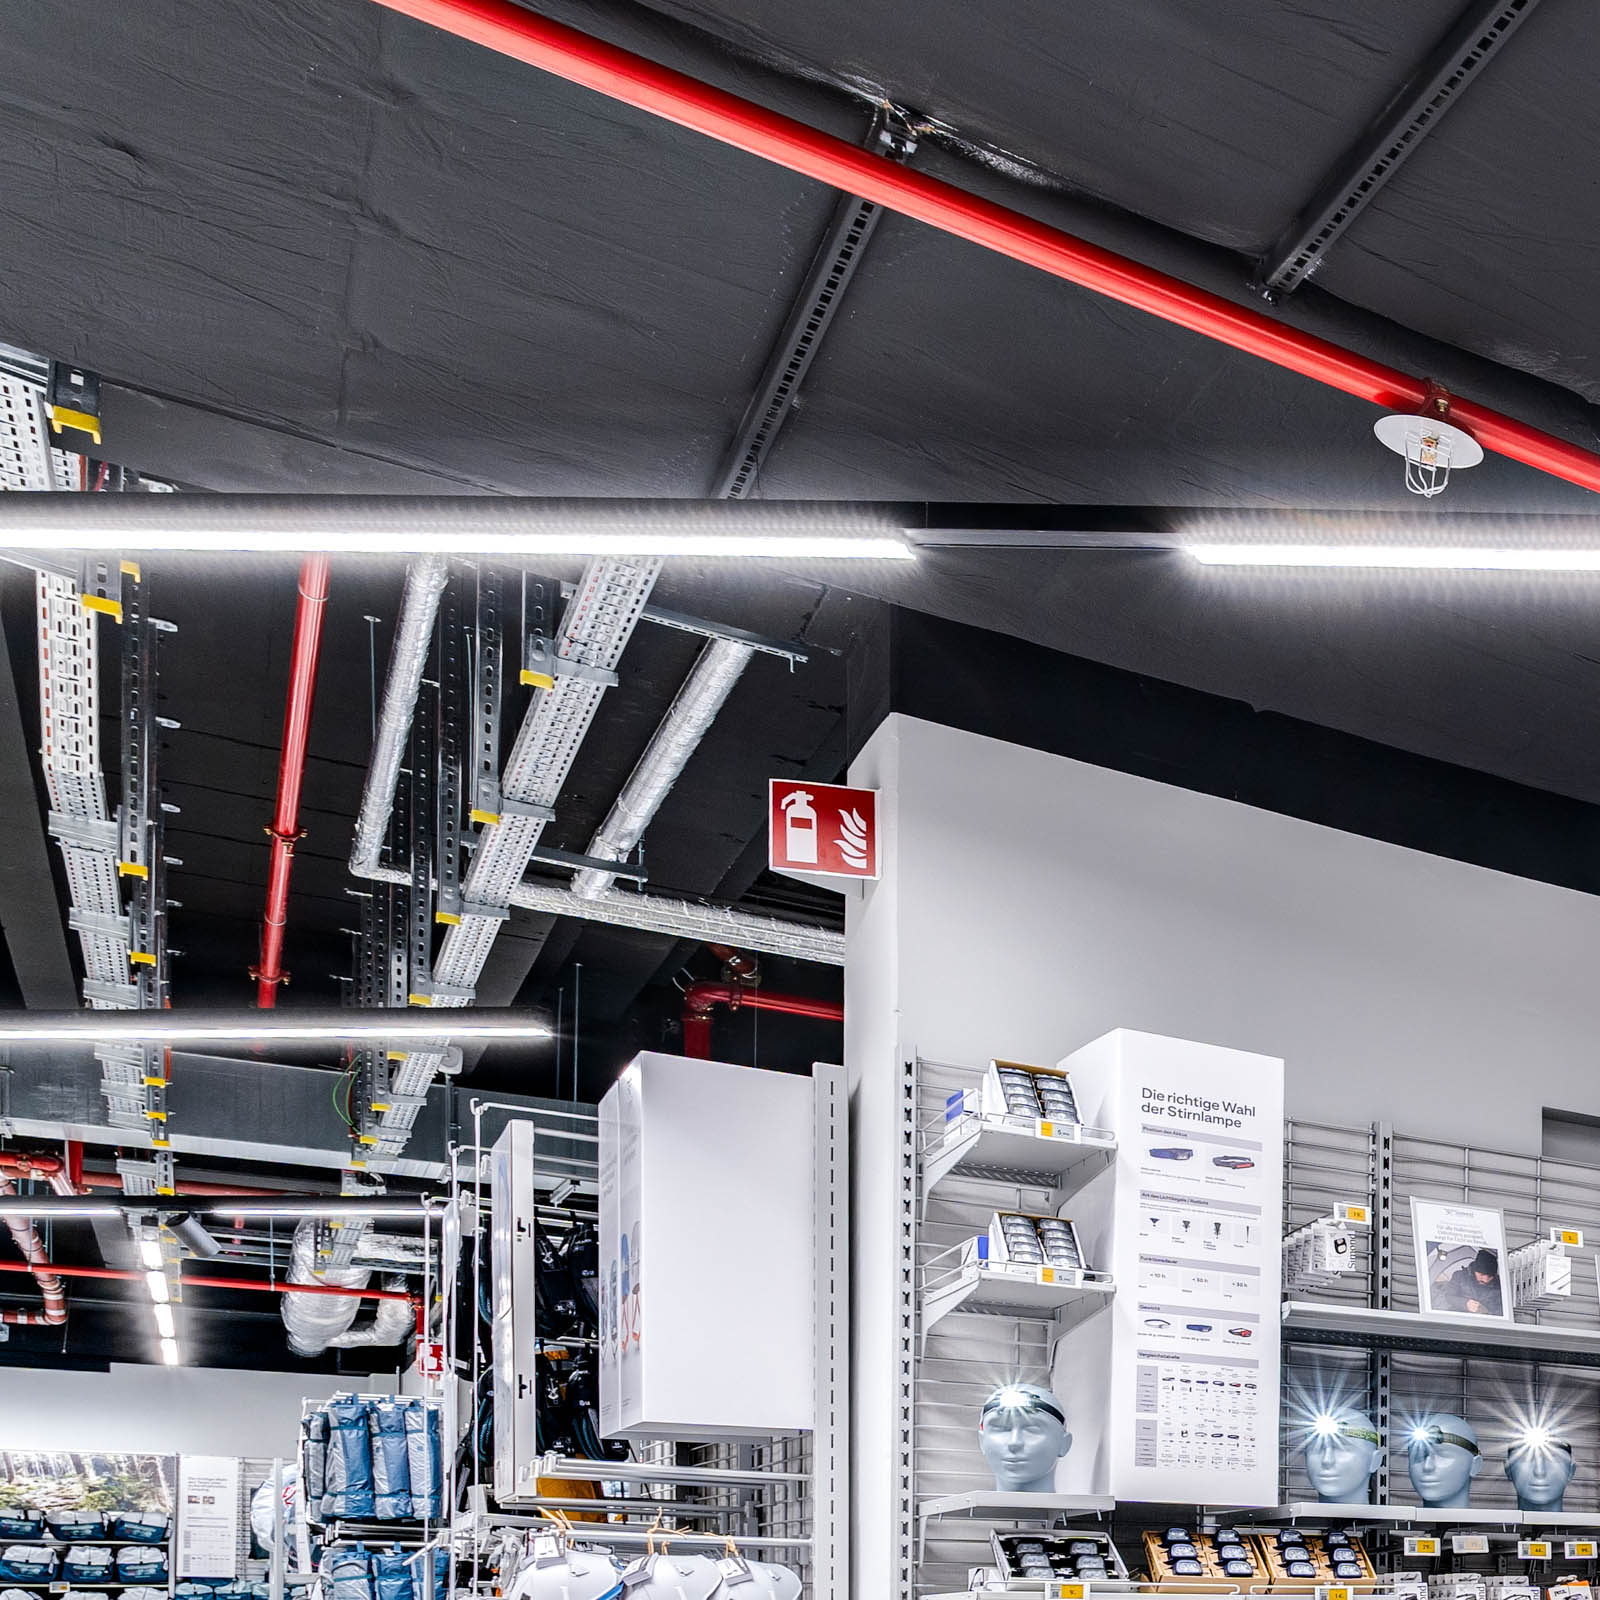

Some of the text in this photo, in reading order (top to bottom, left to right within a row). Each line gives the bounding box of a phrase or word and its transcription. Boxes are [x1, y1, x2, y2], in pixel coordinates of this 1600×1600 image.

[1141, 1102, 1242, 1128] der Stirnlampe
[1142, 1087, 1256, 1117] Die richtige Wahl
[1347, 1232, 1356, 1269] Simond
